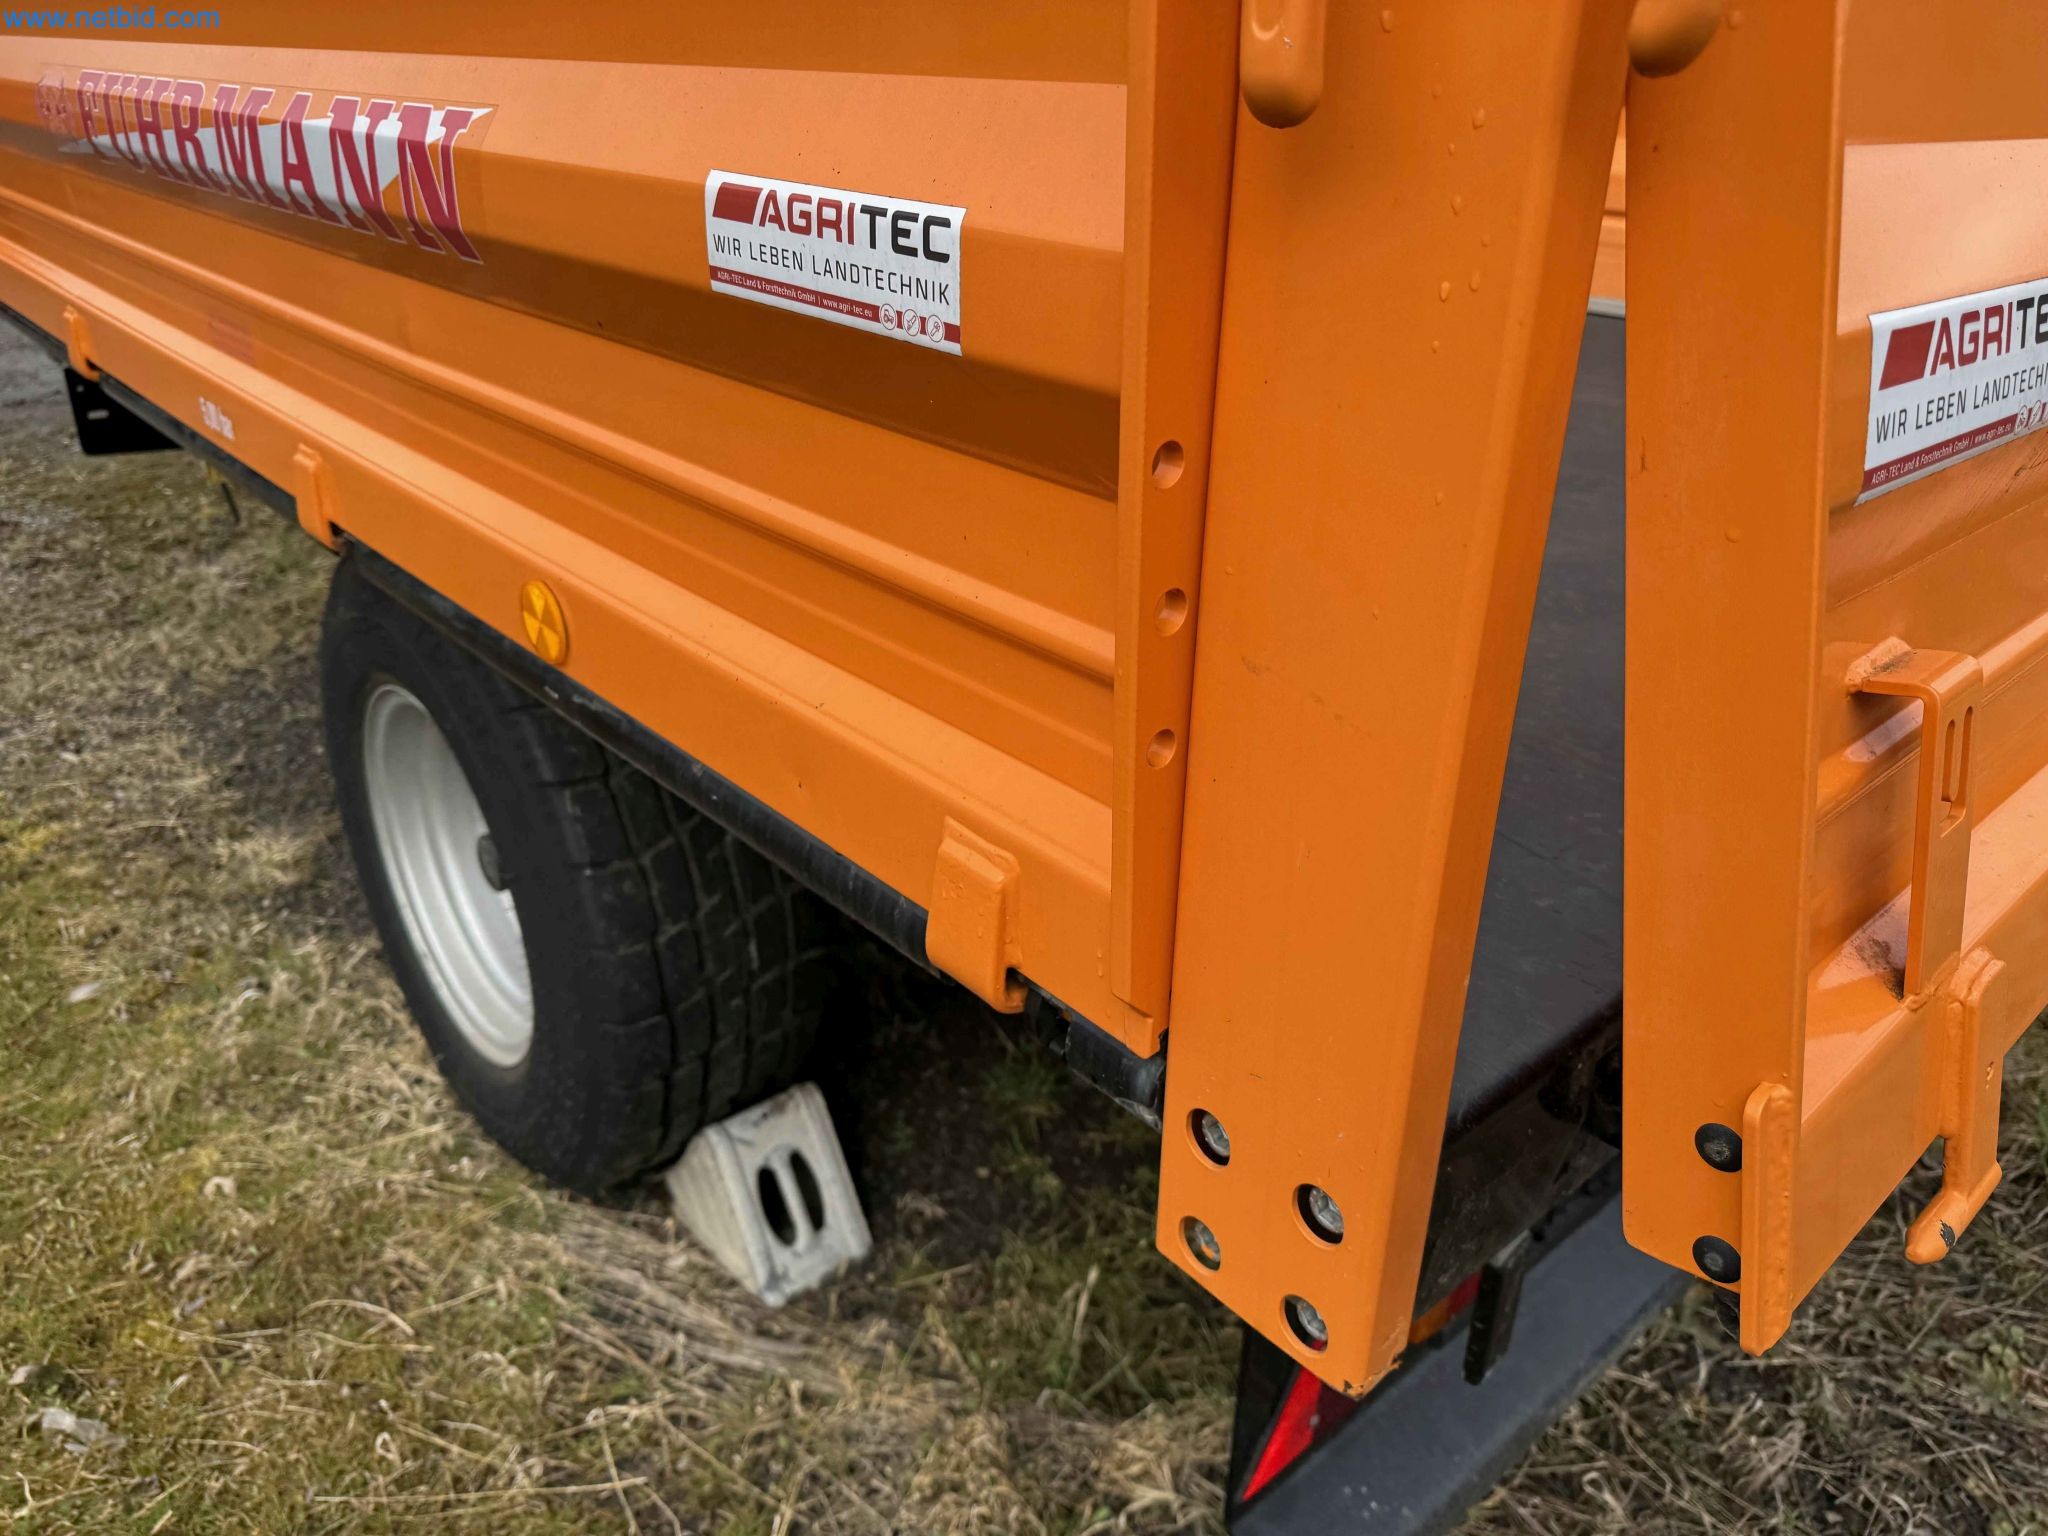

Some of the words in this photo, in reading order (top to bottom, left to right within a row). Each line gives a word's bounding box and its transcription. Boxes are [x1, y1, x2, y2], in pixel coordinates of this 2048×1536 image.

[76, 69, 484, 264] FUHRMANN
[759, 189, 952, 264] AGRITEC
[713, 233, 742, 258] WIR
[749, 241, 803, 272] LEBEN
[812, 255, 950, 306] LANDTECHNIK
[743, 276, 757, 288] Land
[798, 291, 816, 303] GmbH
[822, 298, 873, 318] www.agri-tec.eu
[1876, 408, 1908, 444] WIR
[1915, 388, 1967, 430] LEBEN
[1973, 362, 2048, 410] LANDTECH
[1871, 464, 1900, 485] AGRI-TEC
[1900, 458, 1916, 474] Land
[1953, 436, 1970, 453] GmbH
